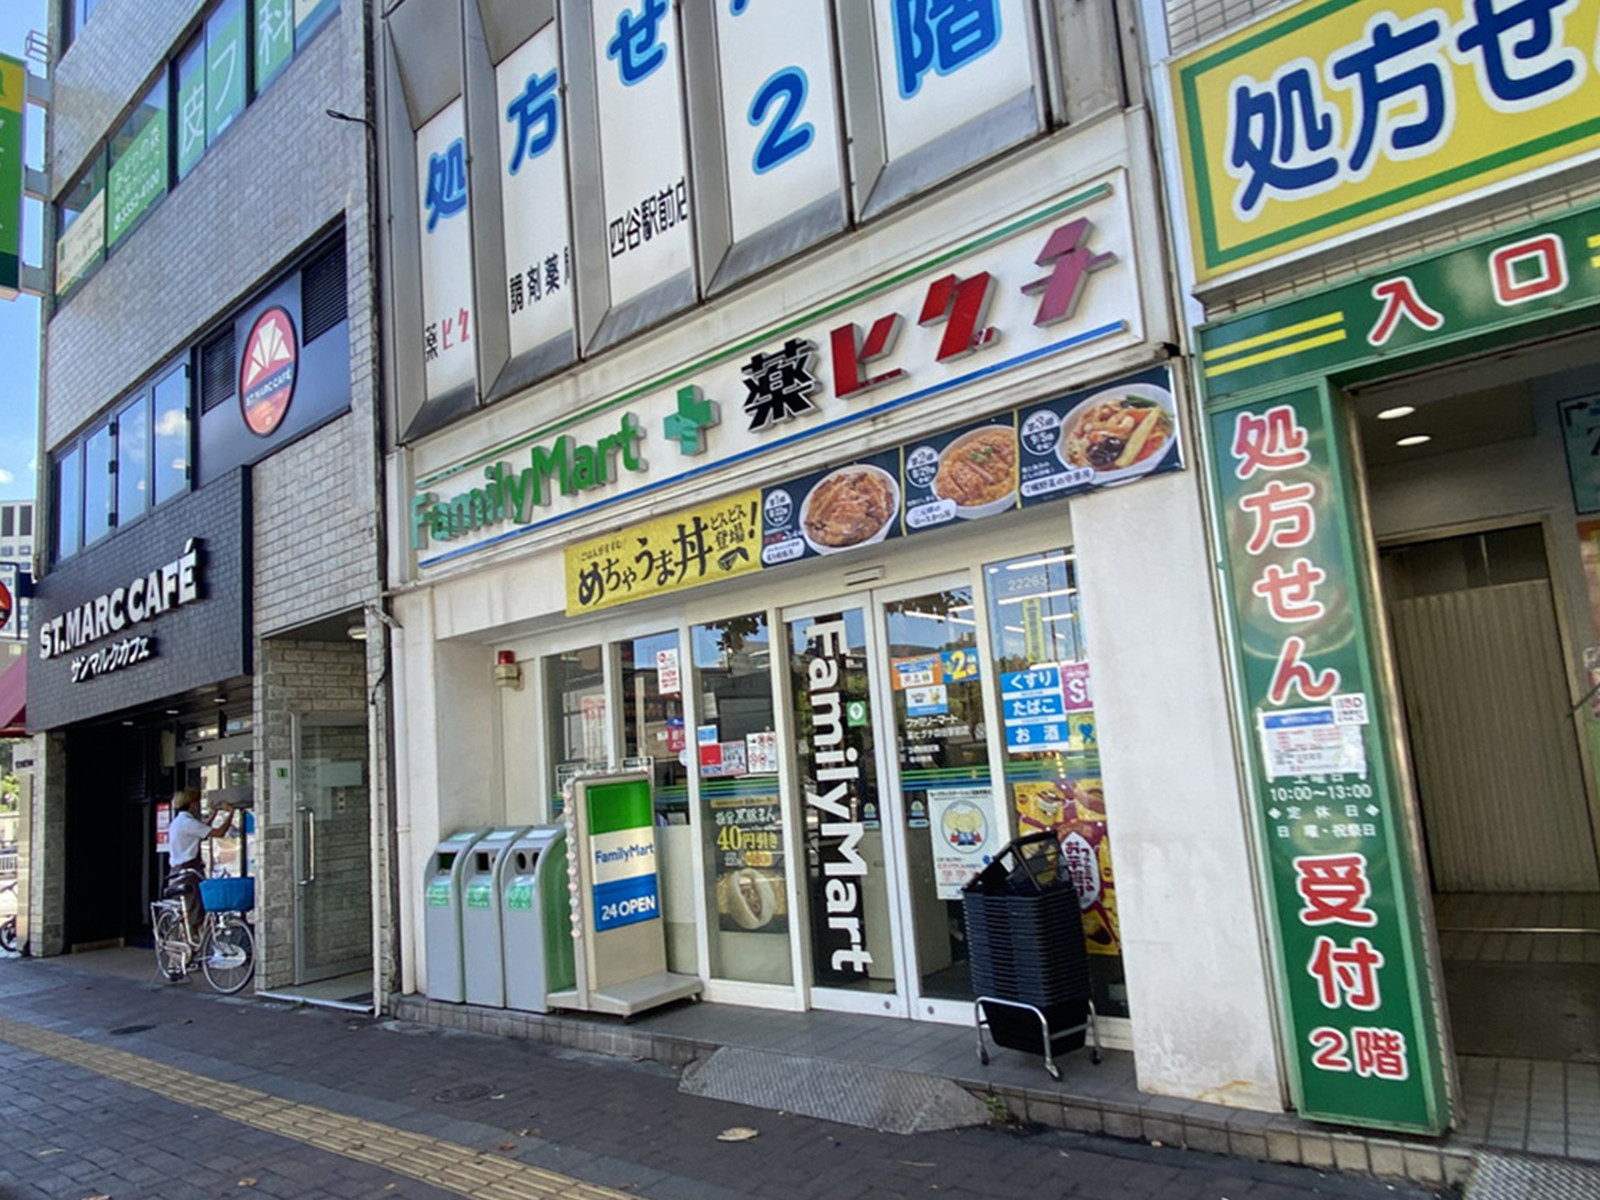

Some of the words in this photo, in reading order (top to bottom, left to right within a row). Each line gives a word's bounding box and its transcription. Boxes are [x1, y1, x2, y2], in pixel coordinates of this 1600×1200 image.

[510, 246, 570, 315] 調剤薬
[1367, 233, 1568, 346] 入口
[410, 411, 646, 550] FamilyMart
[128, 538, 199, 623] CAFÉ
[578, 516, 714, 606] めちゃうま丼
[1232, 404, 1339, 706] 処方せん
[1010, 670, 1051, 690] くすり
[1012, 698, 1056, 717] たばこ
[806, 620, 874, 973] FamilyMart
[594, 843, 655, 865] FamilyMart
[716, 825, 779, 850] 40円引き
[601, 905, 619, 921] 24
[619, 895, 656, 917] OPEN
[1292, 852, 1386, 1012] 受付
[1308, 1026, 1409, 1081] 2階
